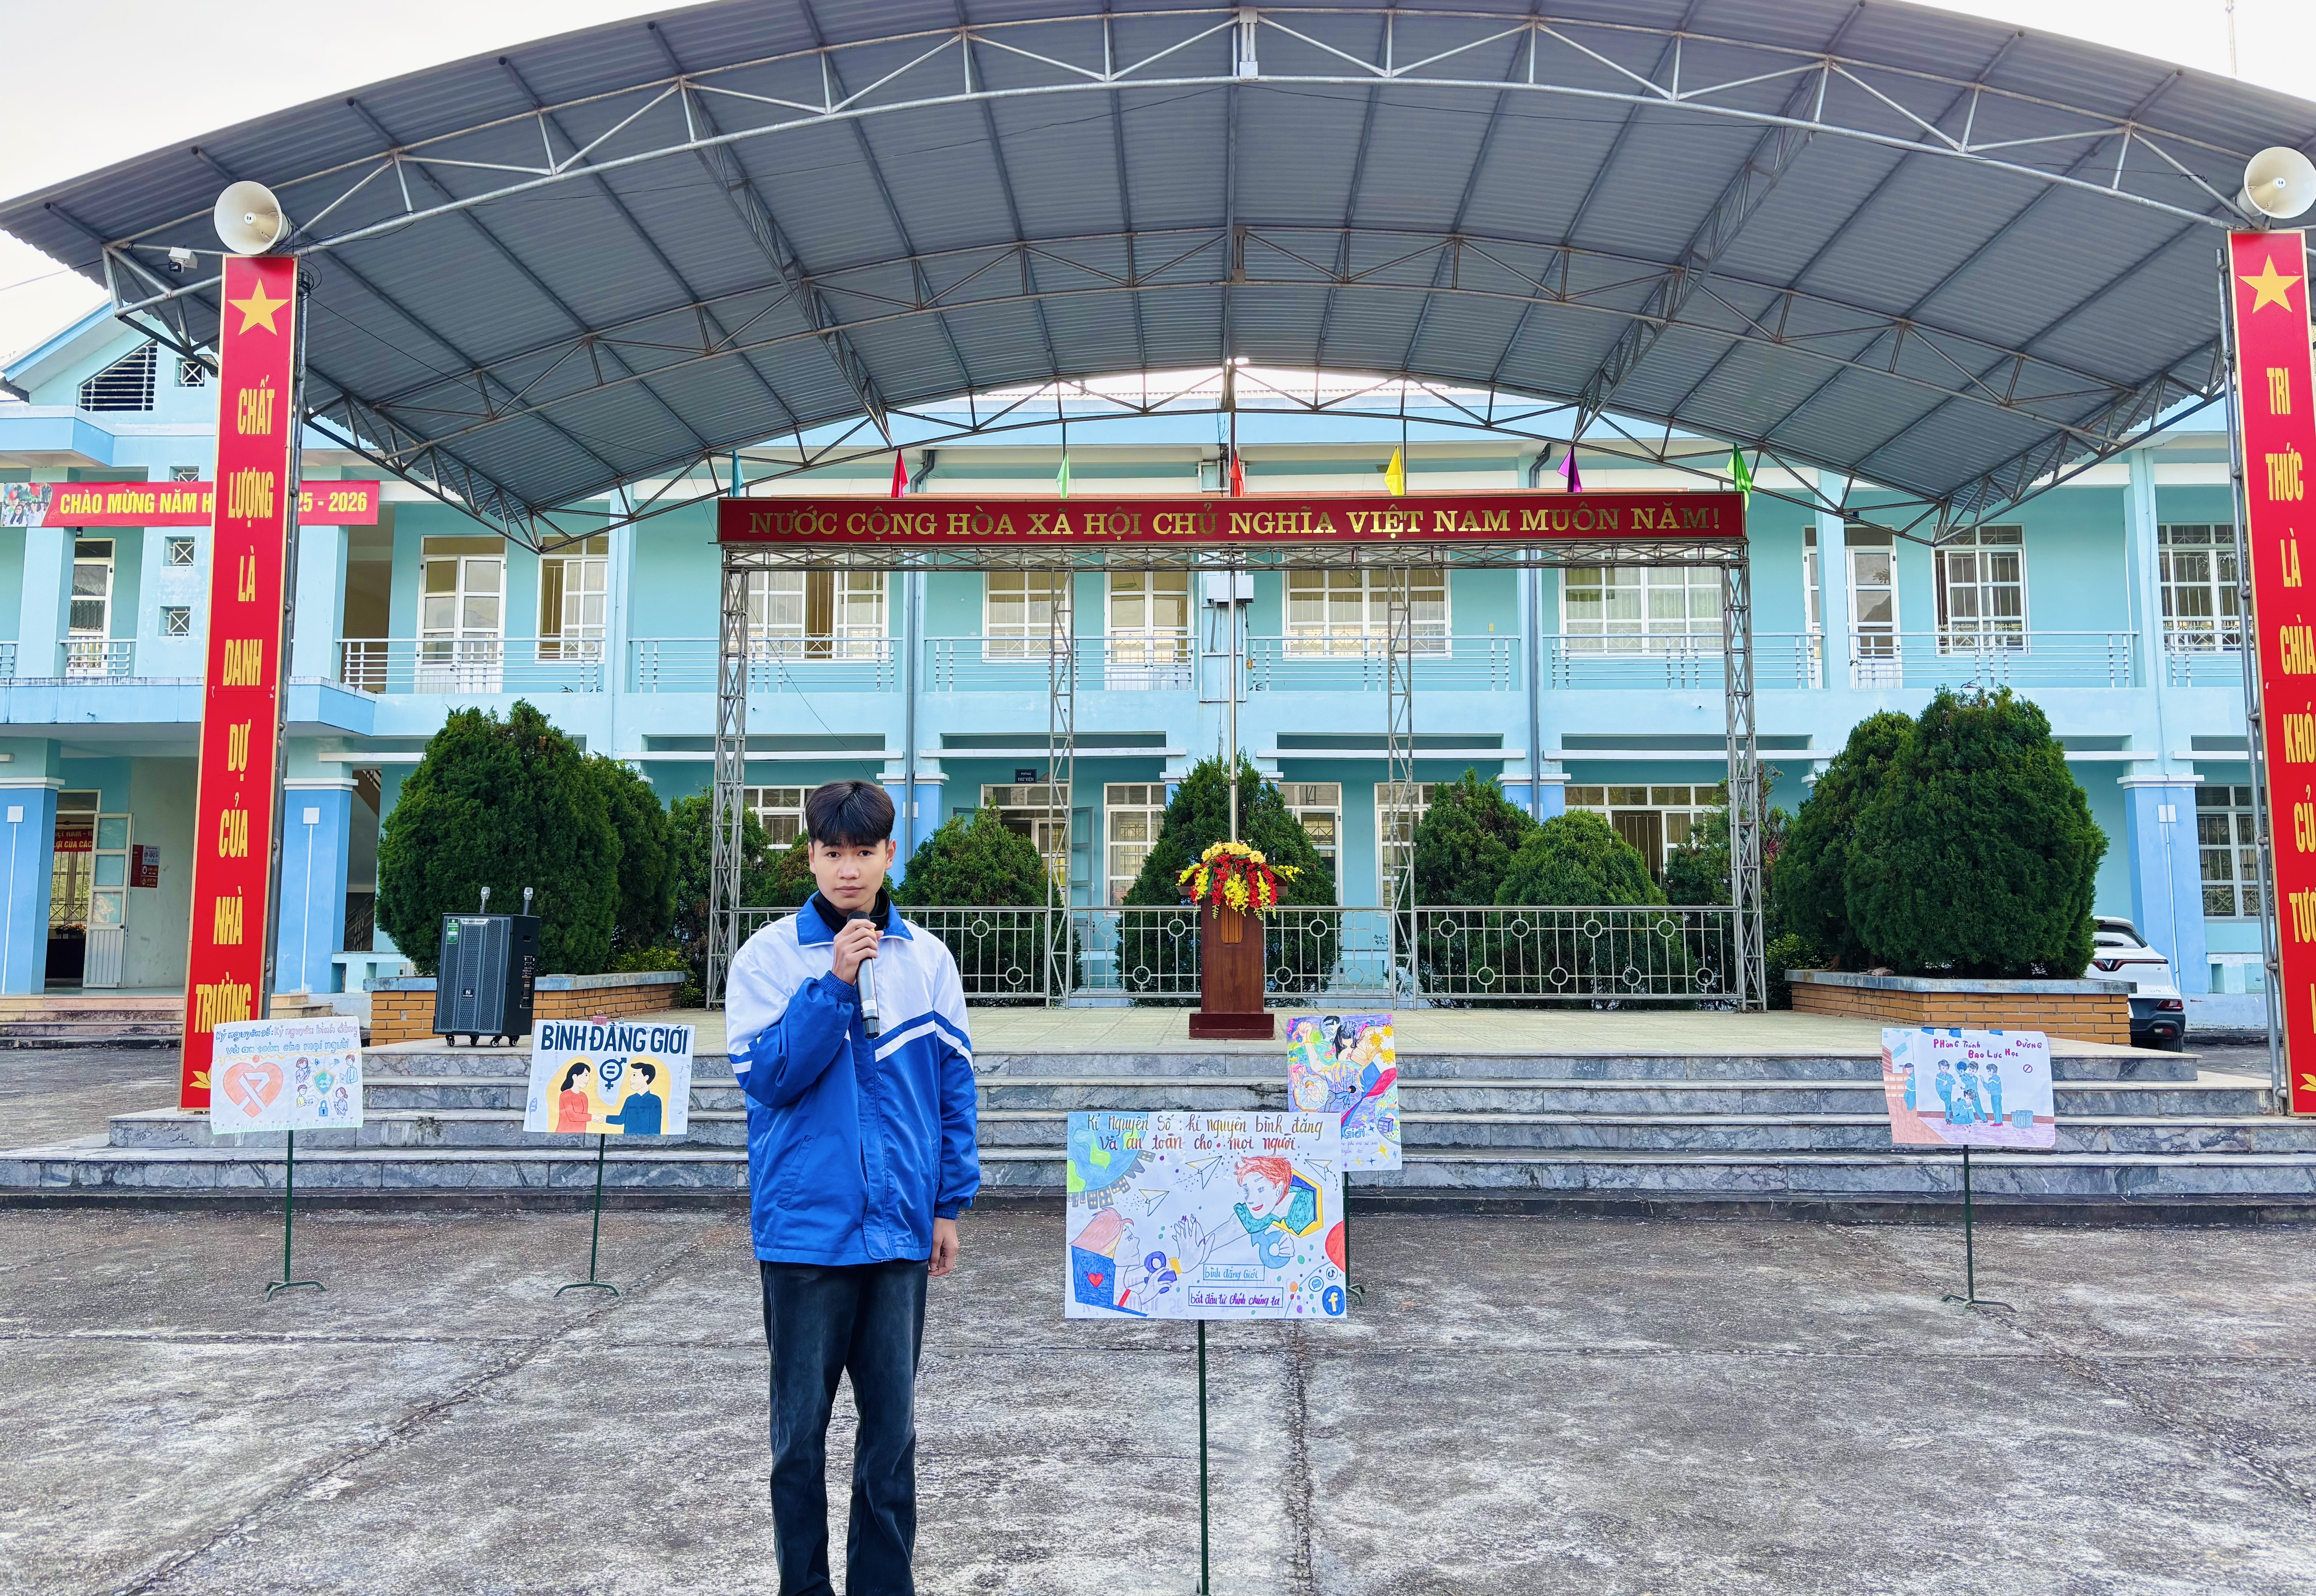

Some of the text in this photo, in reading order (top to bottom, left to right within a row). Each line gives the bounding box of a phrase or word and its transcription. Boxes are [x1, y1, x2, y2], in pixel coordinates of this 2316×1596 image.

[238, 375, 274, 435] CHẤT
[2267, 368, 2290, 415] TRI
[228, 467, 274, 527] LƯỢNG
[2265, 442, 2303, 501] THỨC
[60, 489, 102, 514] CHÀO
[107, 489, 155, 513] MỪNG
[160, 488, 197, 513] NĂM
[328, 492, 367, 512] 2026
[749, 501, 1720, 541] NƯỚC CỘNG HÒA XÃ HỘI CHỦ NGHĨA VIỆT NAM MUÔN NĂM!
[238, 546, 255, 602] LÀ
[2280, 528, 2302, 587] LÀ
[223, 639, 262, 686] DANH
[2280, 614, 2316, 675] CHÌA
[228, 719, 251, 782] DỰ
[2283, 701, 2316, 763] KHÓ
[55, 840, 63, 849] ỢI
[64, 839, 77, 848] CỦA
[219, 792, 247, 858] CỦA
[2294, 784, 2316, 853] CỦ
[213, 886, 243, 945] NHÀ
[195, 971, 251, 1033] TRƯỜNG
[226, 1044, 240, 1054] và
[257, 1041, 279, 1053] toàn
[283, 1041, 300, 1051] cho
[304, 1040, 322, 1052] mọi
[325, 1037, 349, 1053] người
[228, 1028, 261, 1041] nguyên
[285, 1025, 314, 1038] nguyên
[316, 1022, 335, 1034] bình
[541, 1022, 588, 1051] BÌNH
[650, 1025, 688, 1054] GIỚI
[1126, 1136, 1143, 1150] an
[1194, 1133, 1212, 1150] cho
[1256, 1114, 1284, 1134] bình
[1291, 1113, 1324, 1141] đẳng
[1205, 1266, 1220, 1278] bình
[1190, 1290, 1203, 1304] bắt
[1270, 1296, 1280, 1306] ta
